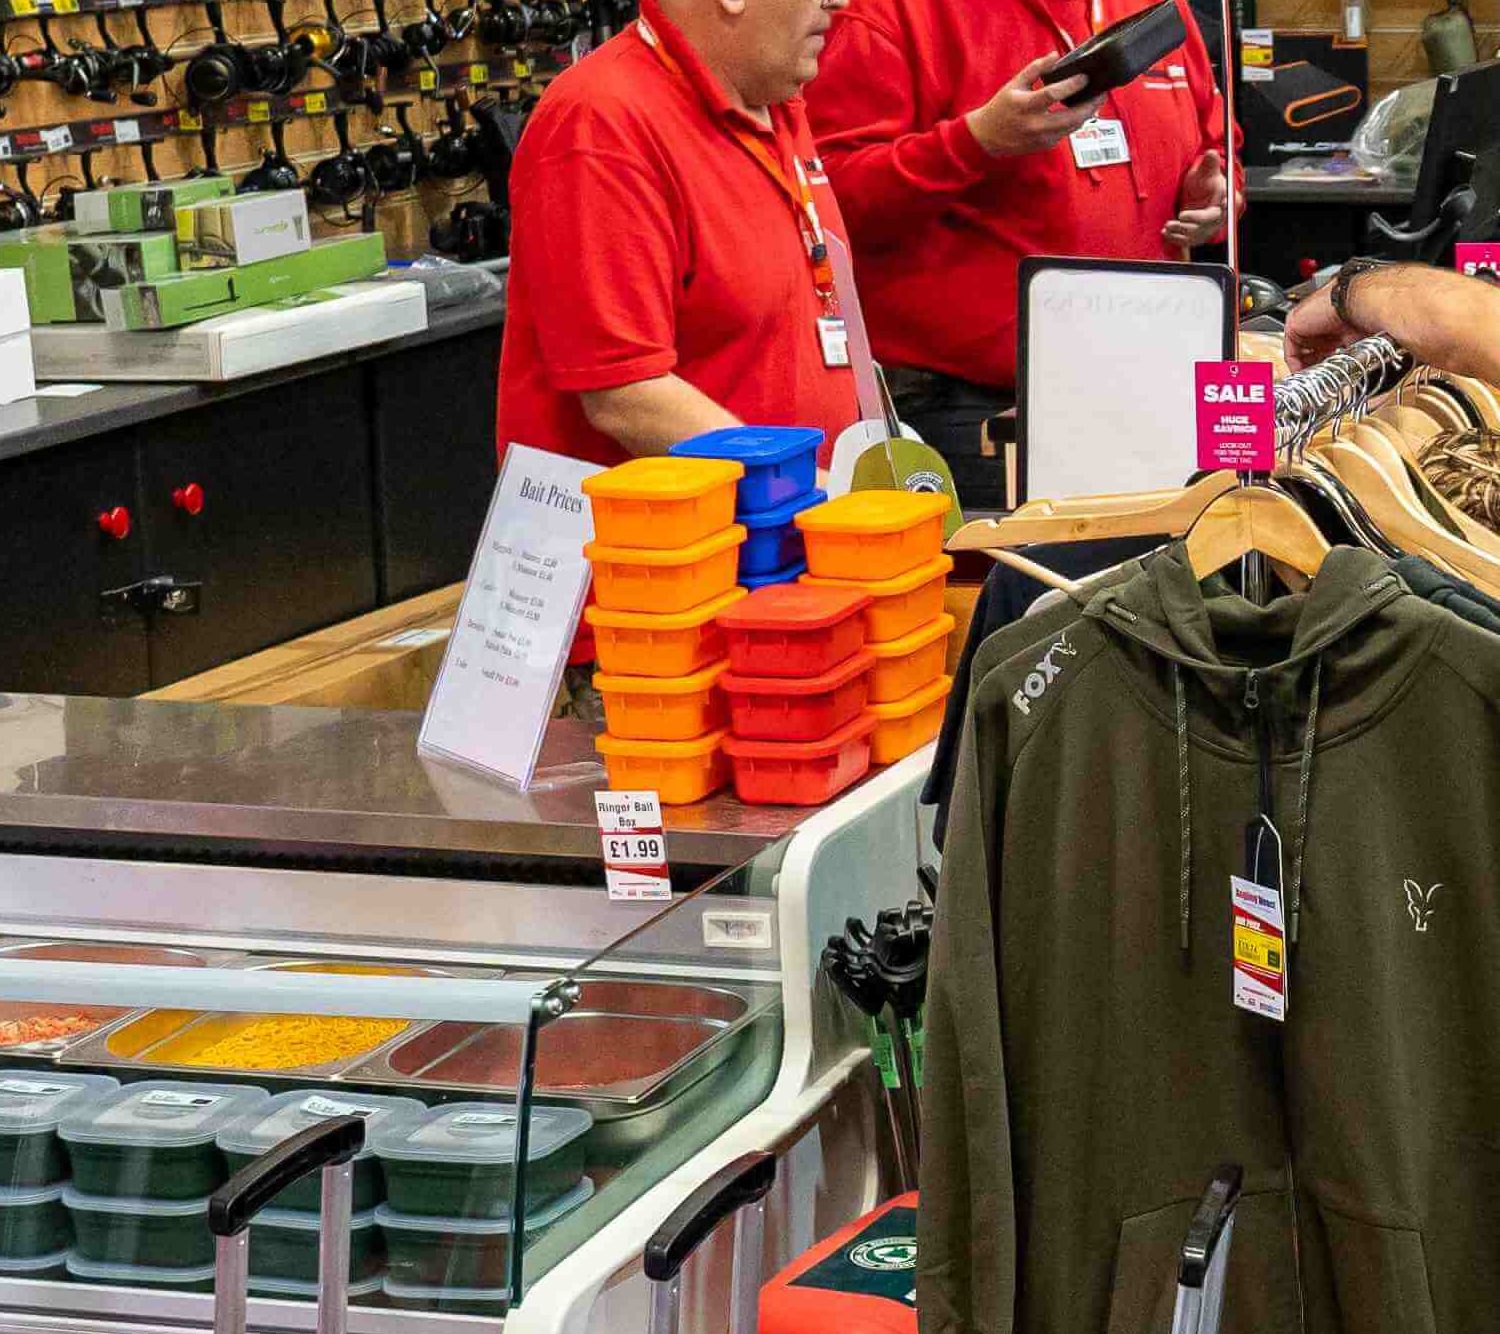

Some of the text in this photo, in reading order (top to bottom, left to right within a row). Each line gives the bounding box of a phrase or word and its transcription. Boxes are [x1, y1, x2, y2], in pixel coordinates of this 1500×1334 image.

[1203, 384, 1266, 403] SALE
[1220, 415, 1250, 424] HUGE
[520, 475, 584, 514] Bait Prices
[1012, 651, 1063, 716] FOX
[619, 817, 637, 827] Box
[610, 839, 660, 858] £1.99
